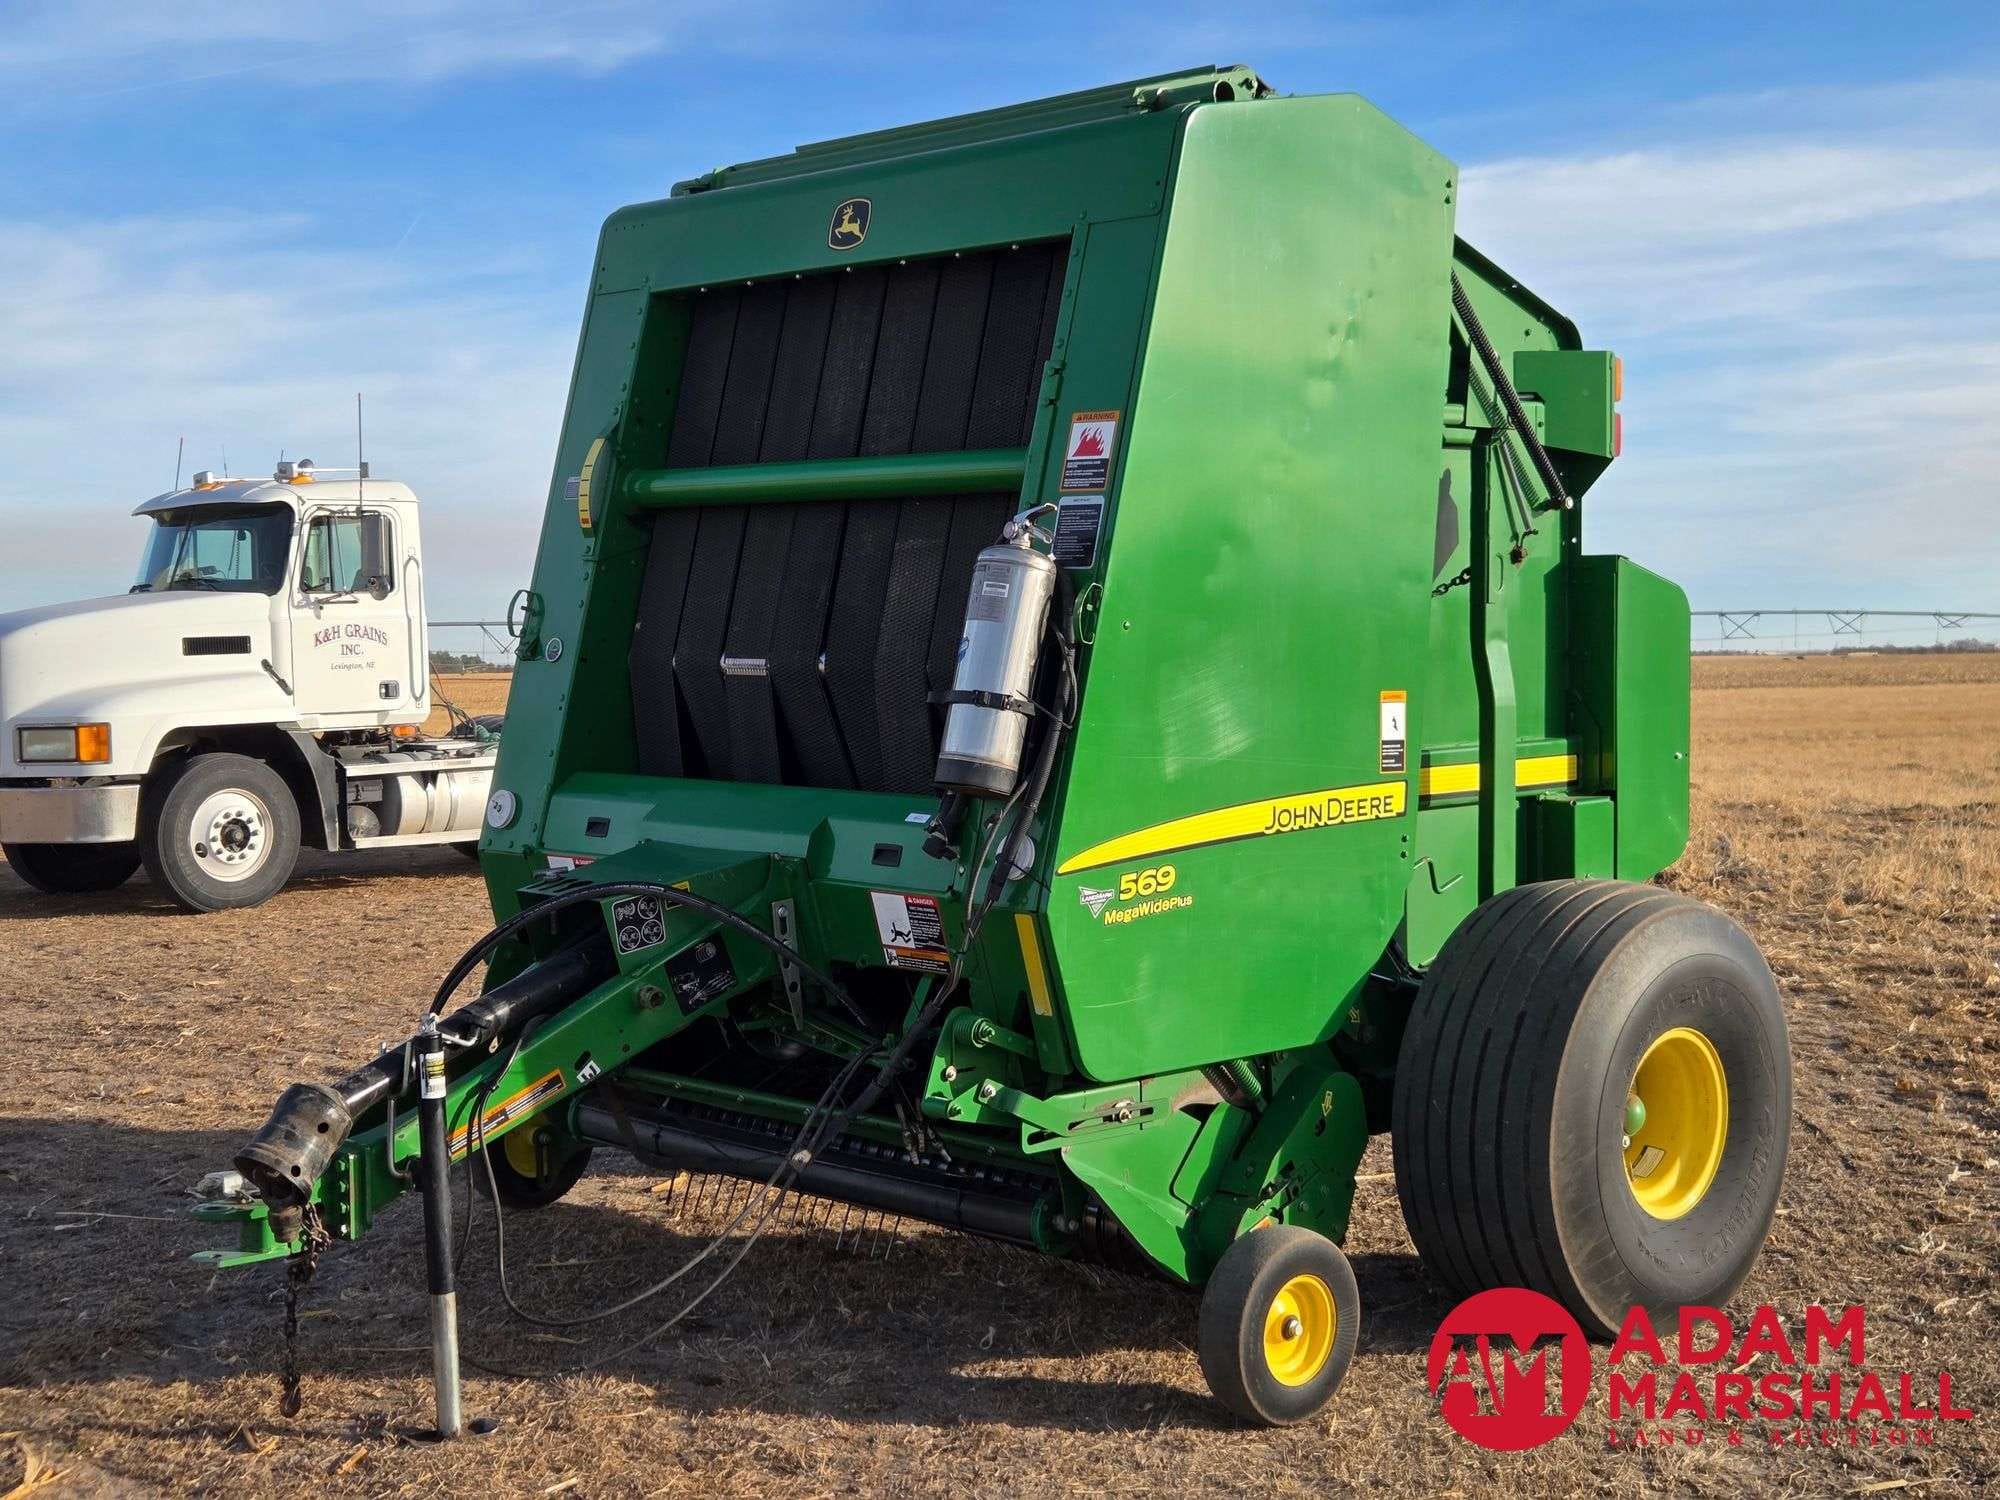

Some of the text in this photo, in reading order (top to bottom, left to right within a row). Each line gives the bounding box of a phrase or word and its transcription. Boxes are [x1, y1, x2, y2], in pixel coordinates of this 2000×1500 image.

[1082, 412, 1115, 420] WARNING
[313, 624, 388, 647] K&H GRAINS
[341, 644, 364, 656] INC.
[1265, 794, 1394, 831] JOHN DEERE
[1118, 864, 1177, 902] 569
[1104, 896, 1193, 925] MegaWidePlus
